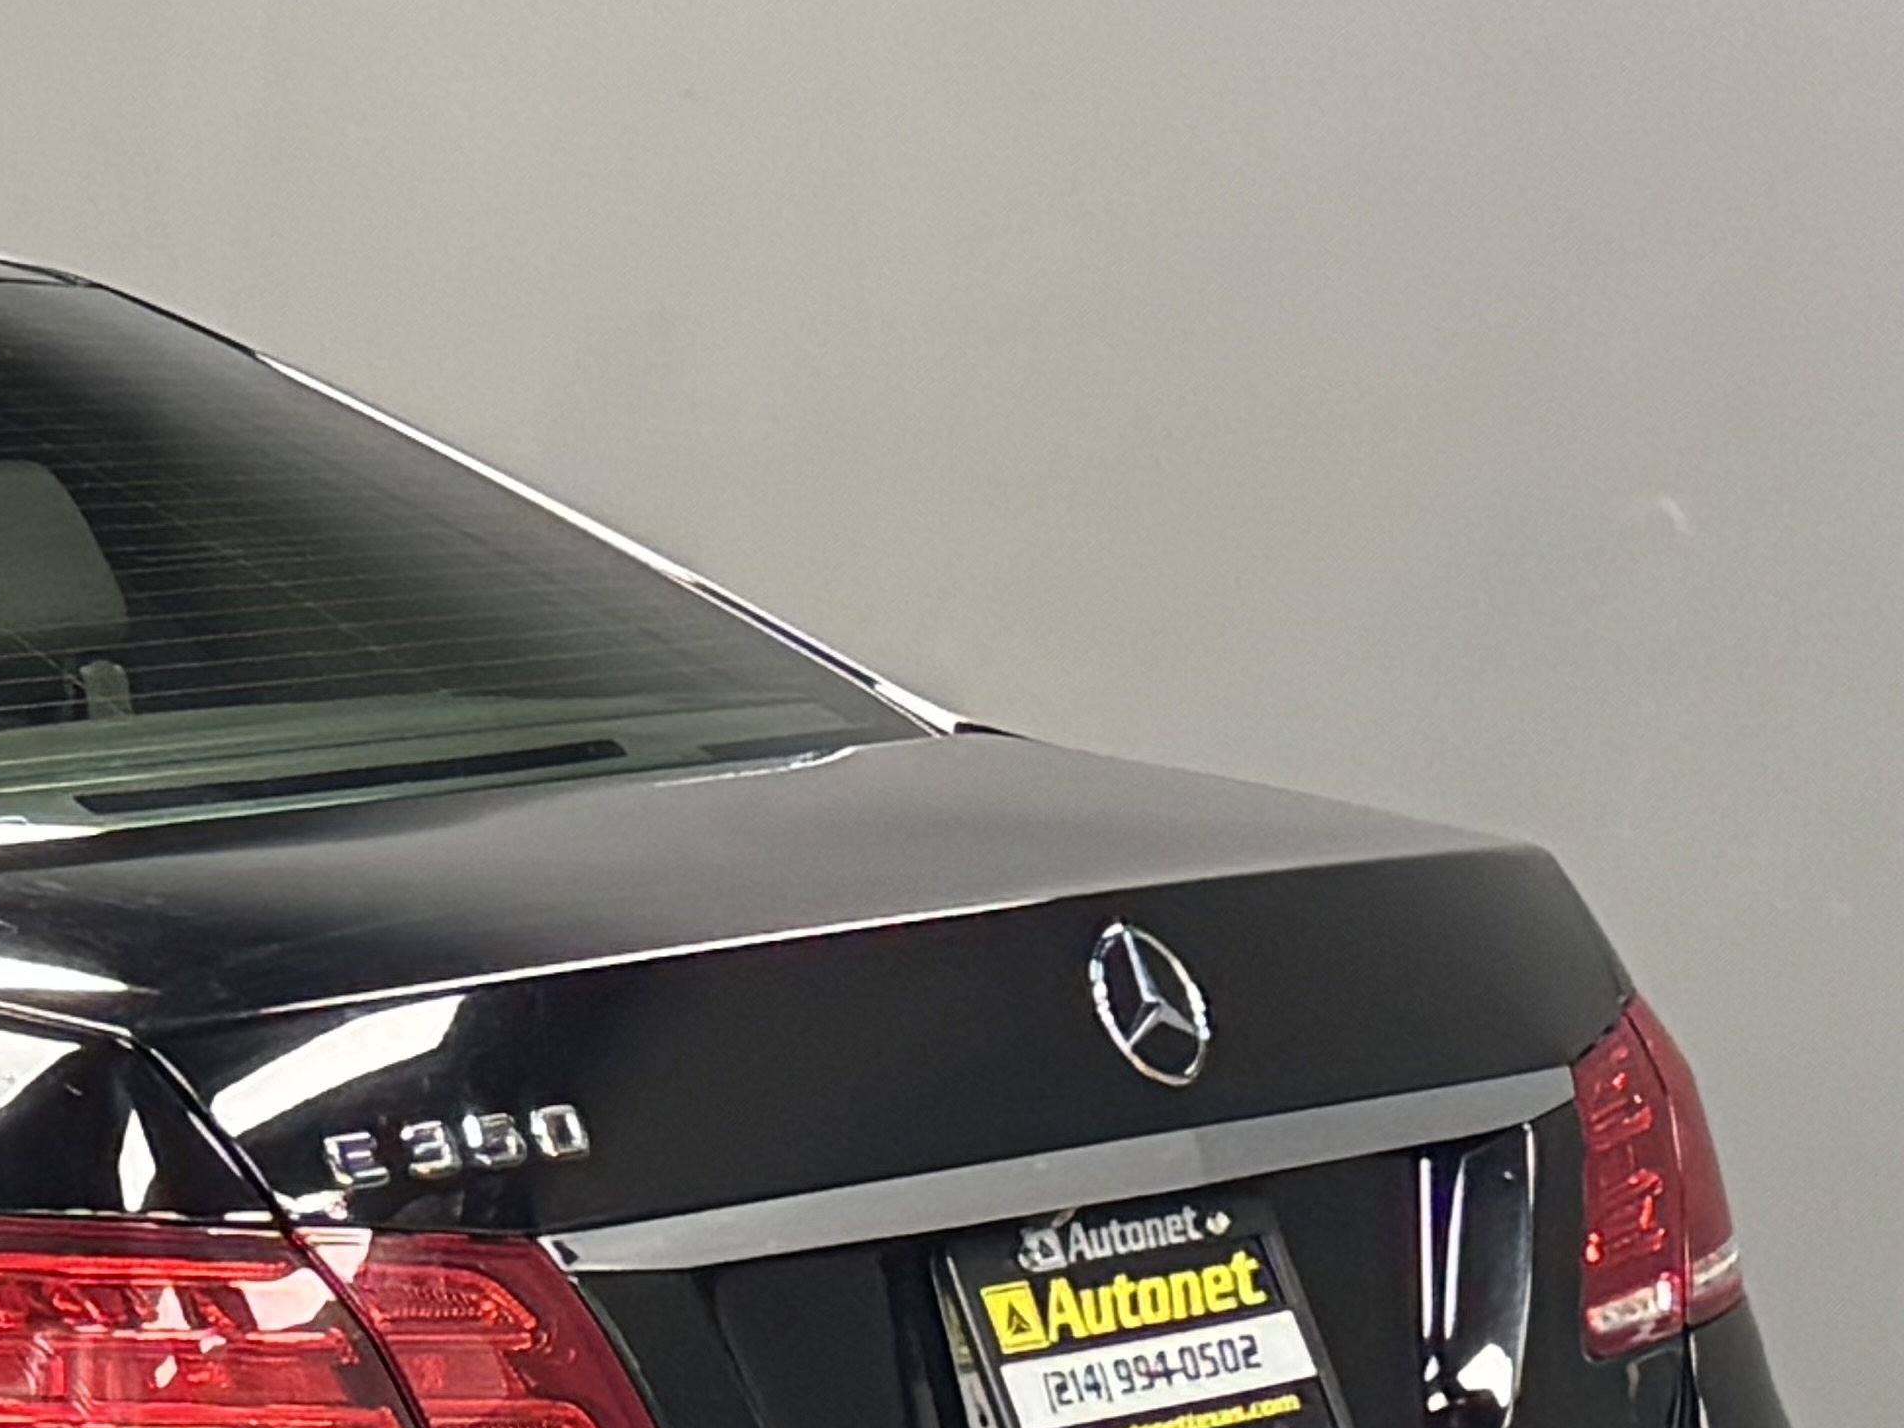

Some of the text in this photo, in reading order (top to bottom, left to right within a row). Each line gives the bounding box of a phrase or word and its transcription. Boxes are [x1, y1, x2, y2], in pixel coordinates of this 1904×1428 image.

[323, 1104, 590, 1188] E 350
[1068, 1205, 1203, 1263] Autonet
[1047, 1250, 1268, 1343] Autonet
[1113, 1334, 1262, 1395] 994-0502
